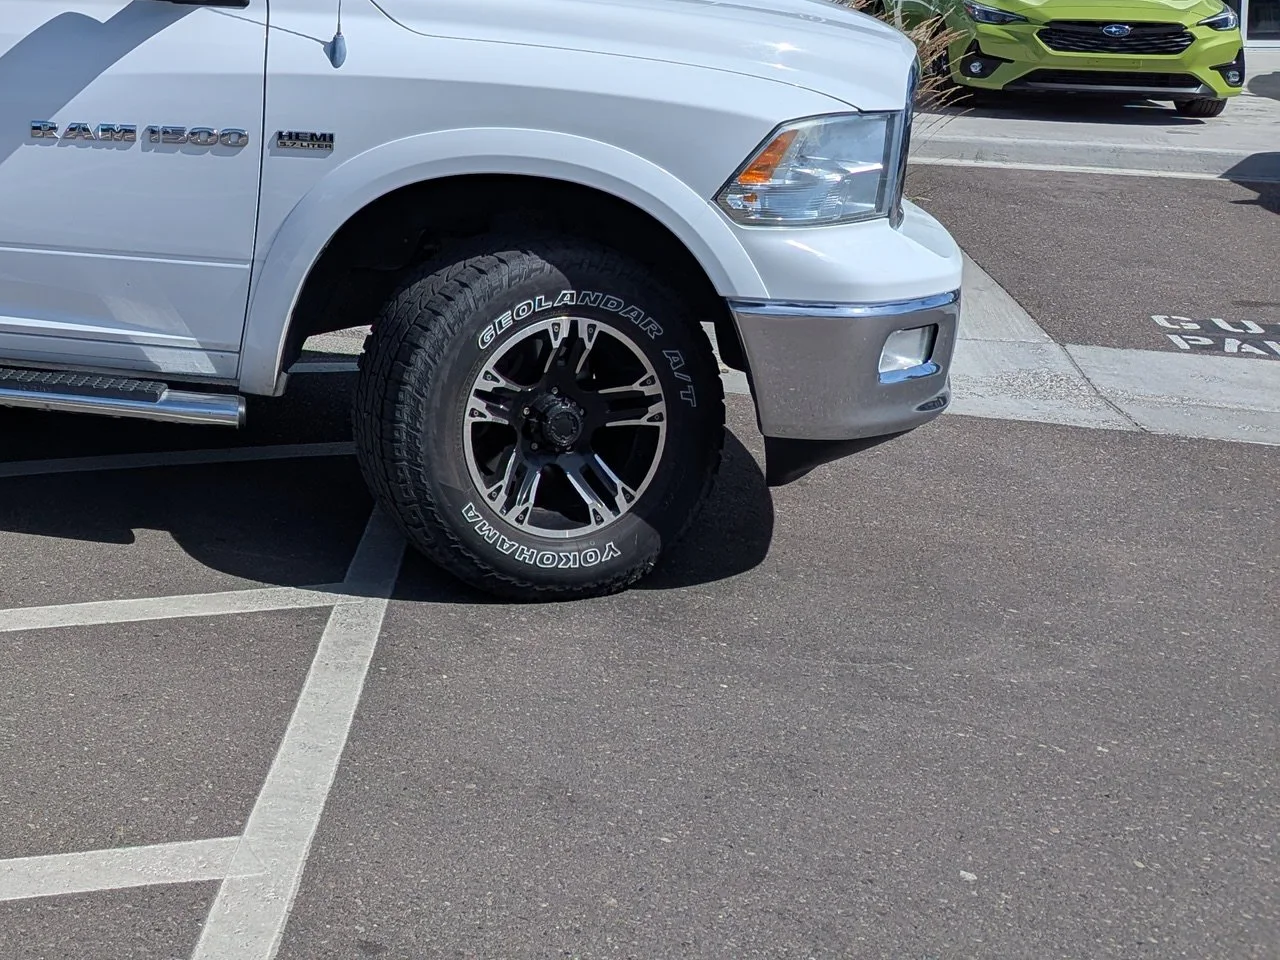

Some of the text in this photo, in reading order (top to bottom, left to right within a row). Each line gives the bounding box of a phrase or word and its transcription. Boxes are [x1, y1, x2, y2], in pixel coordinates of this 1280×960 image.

[31, 120, 250, 147] RAM 1500
[278, 131, 334, 142] HEMI
[478, 290, 698, 408] GEOLANDAR A/T
[461, 502, 622, 569] YOKOHAMA
